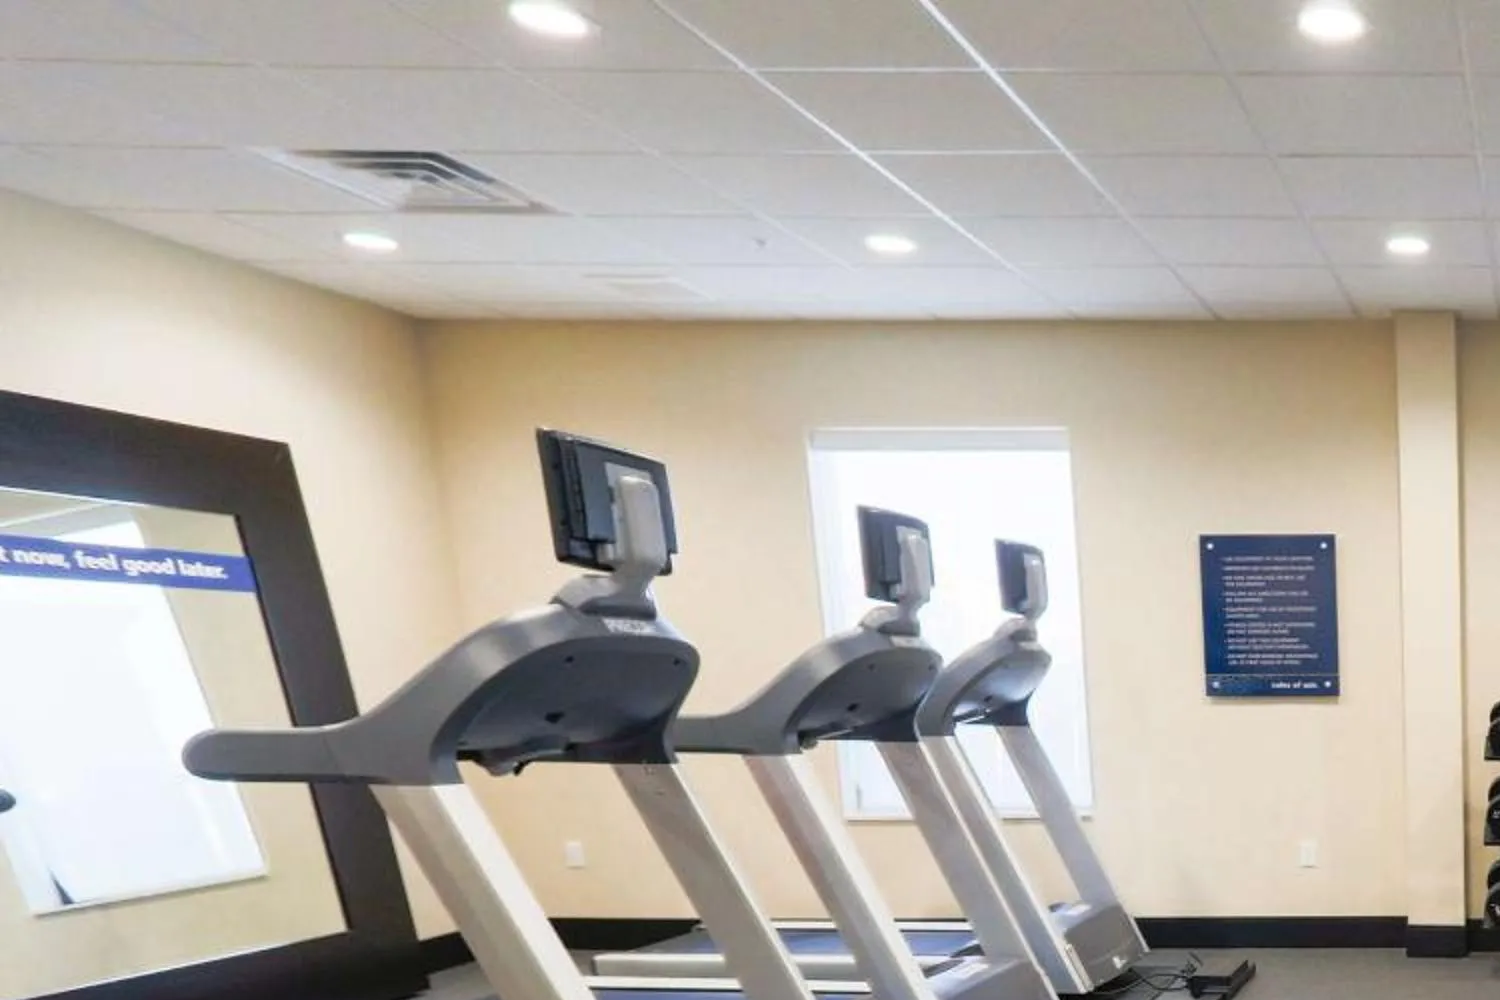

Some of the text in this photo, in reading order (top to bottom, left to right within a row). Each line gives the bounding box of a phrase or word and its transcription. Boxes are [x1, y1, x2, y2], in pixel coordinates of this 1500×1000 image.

[13, 549, 71, 570] now,
[74, 550, 120, 572] feel
[121, 557, 177, 577] good
[177, 559, 229, 580] later.
